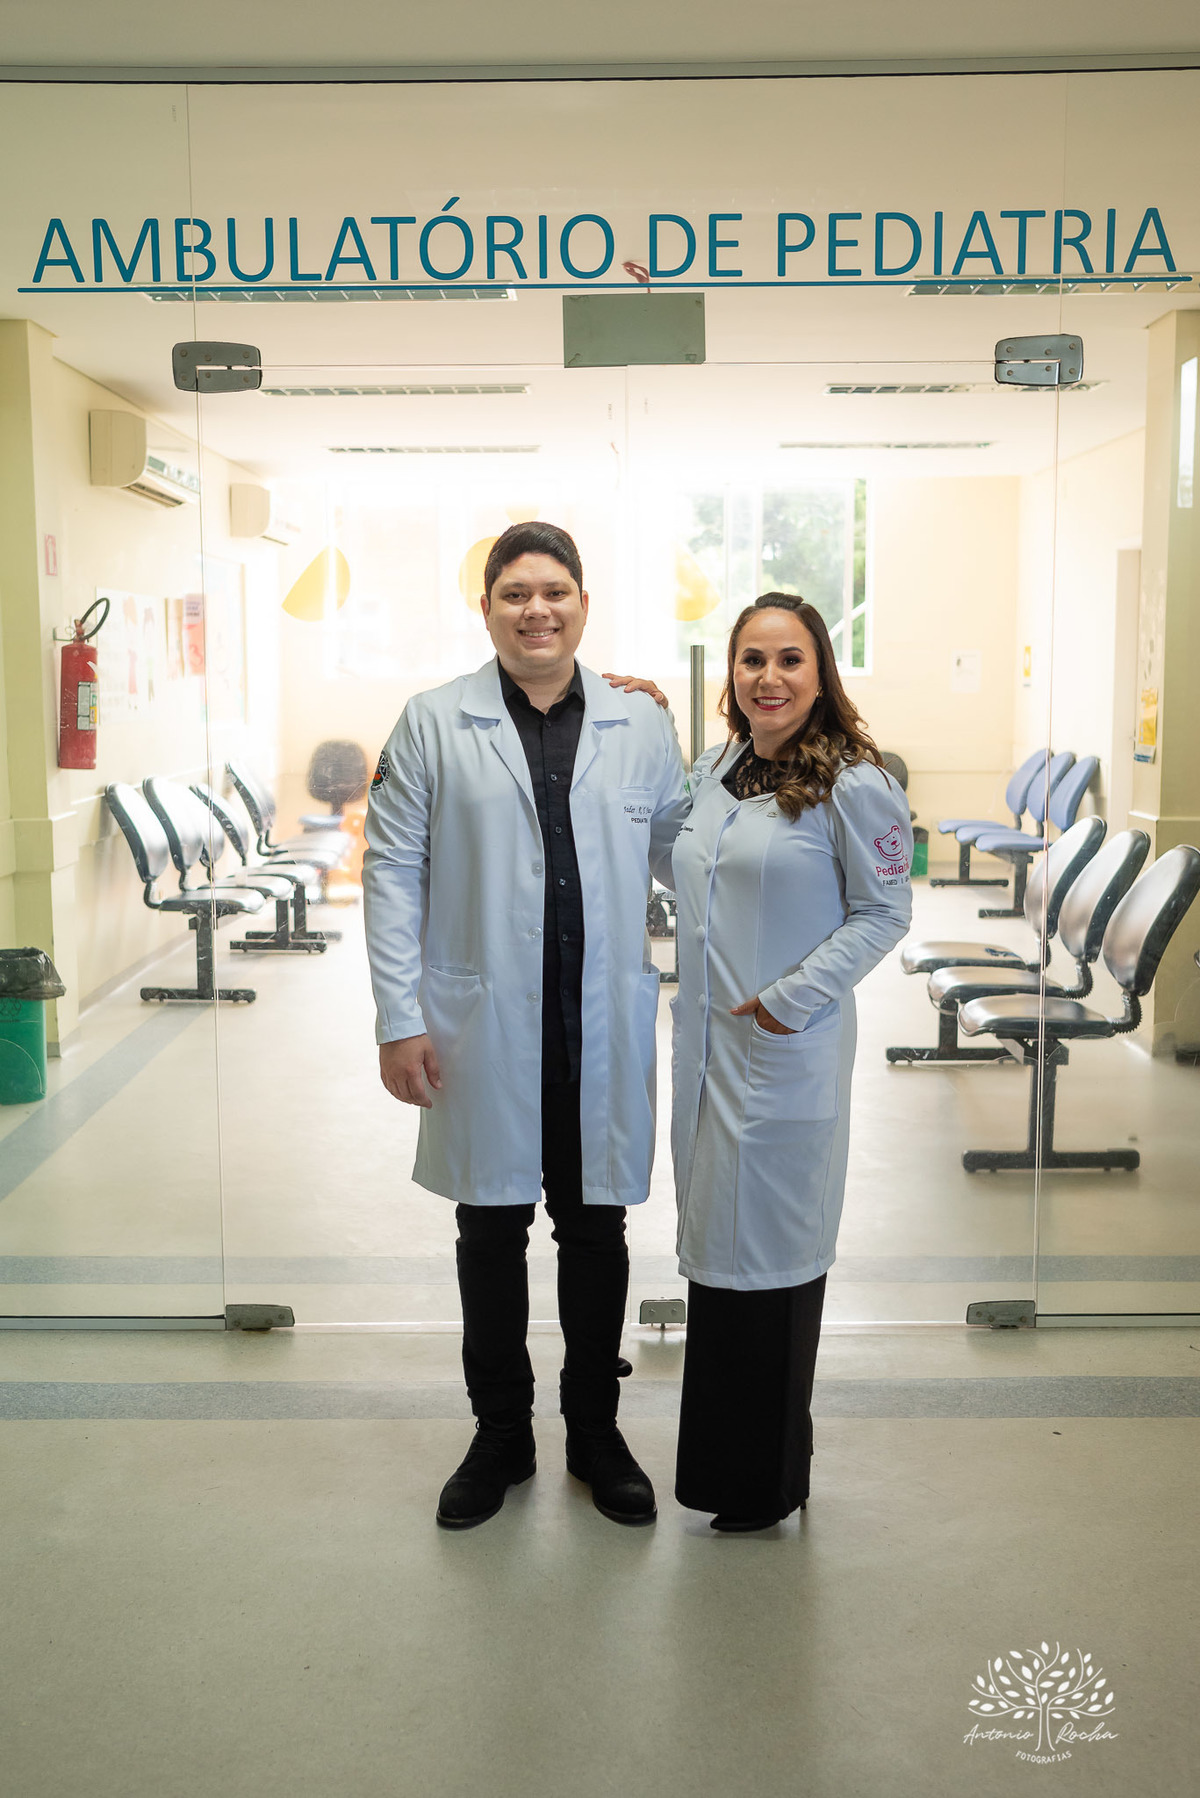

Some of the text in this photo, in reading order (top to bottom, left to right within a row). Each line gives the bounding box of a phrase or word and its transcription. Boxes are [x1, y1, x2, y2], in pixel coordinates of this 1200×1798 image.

[32, 196, 1177, 284] AMBULATÓRIO DE PEDIATRIA
